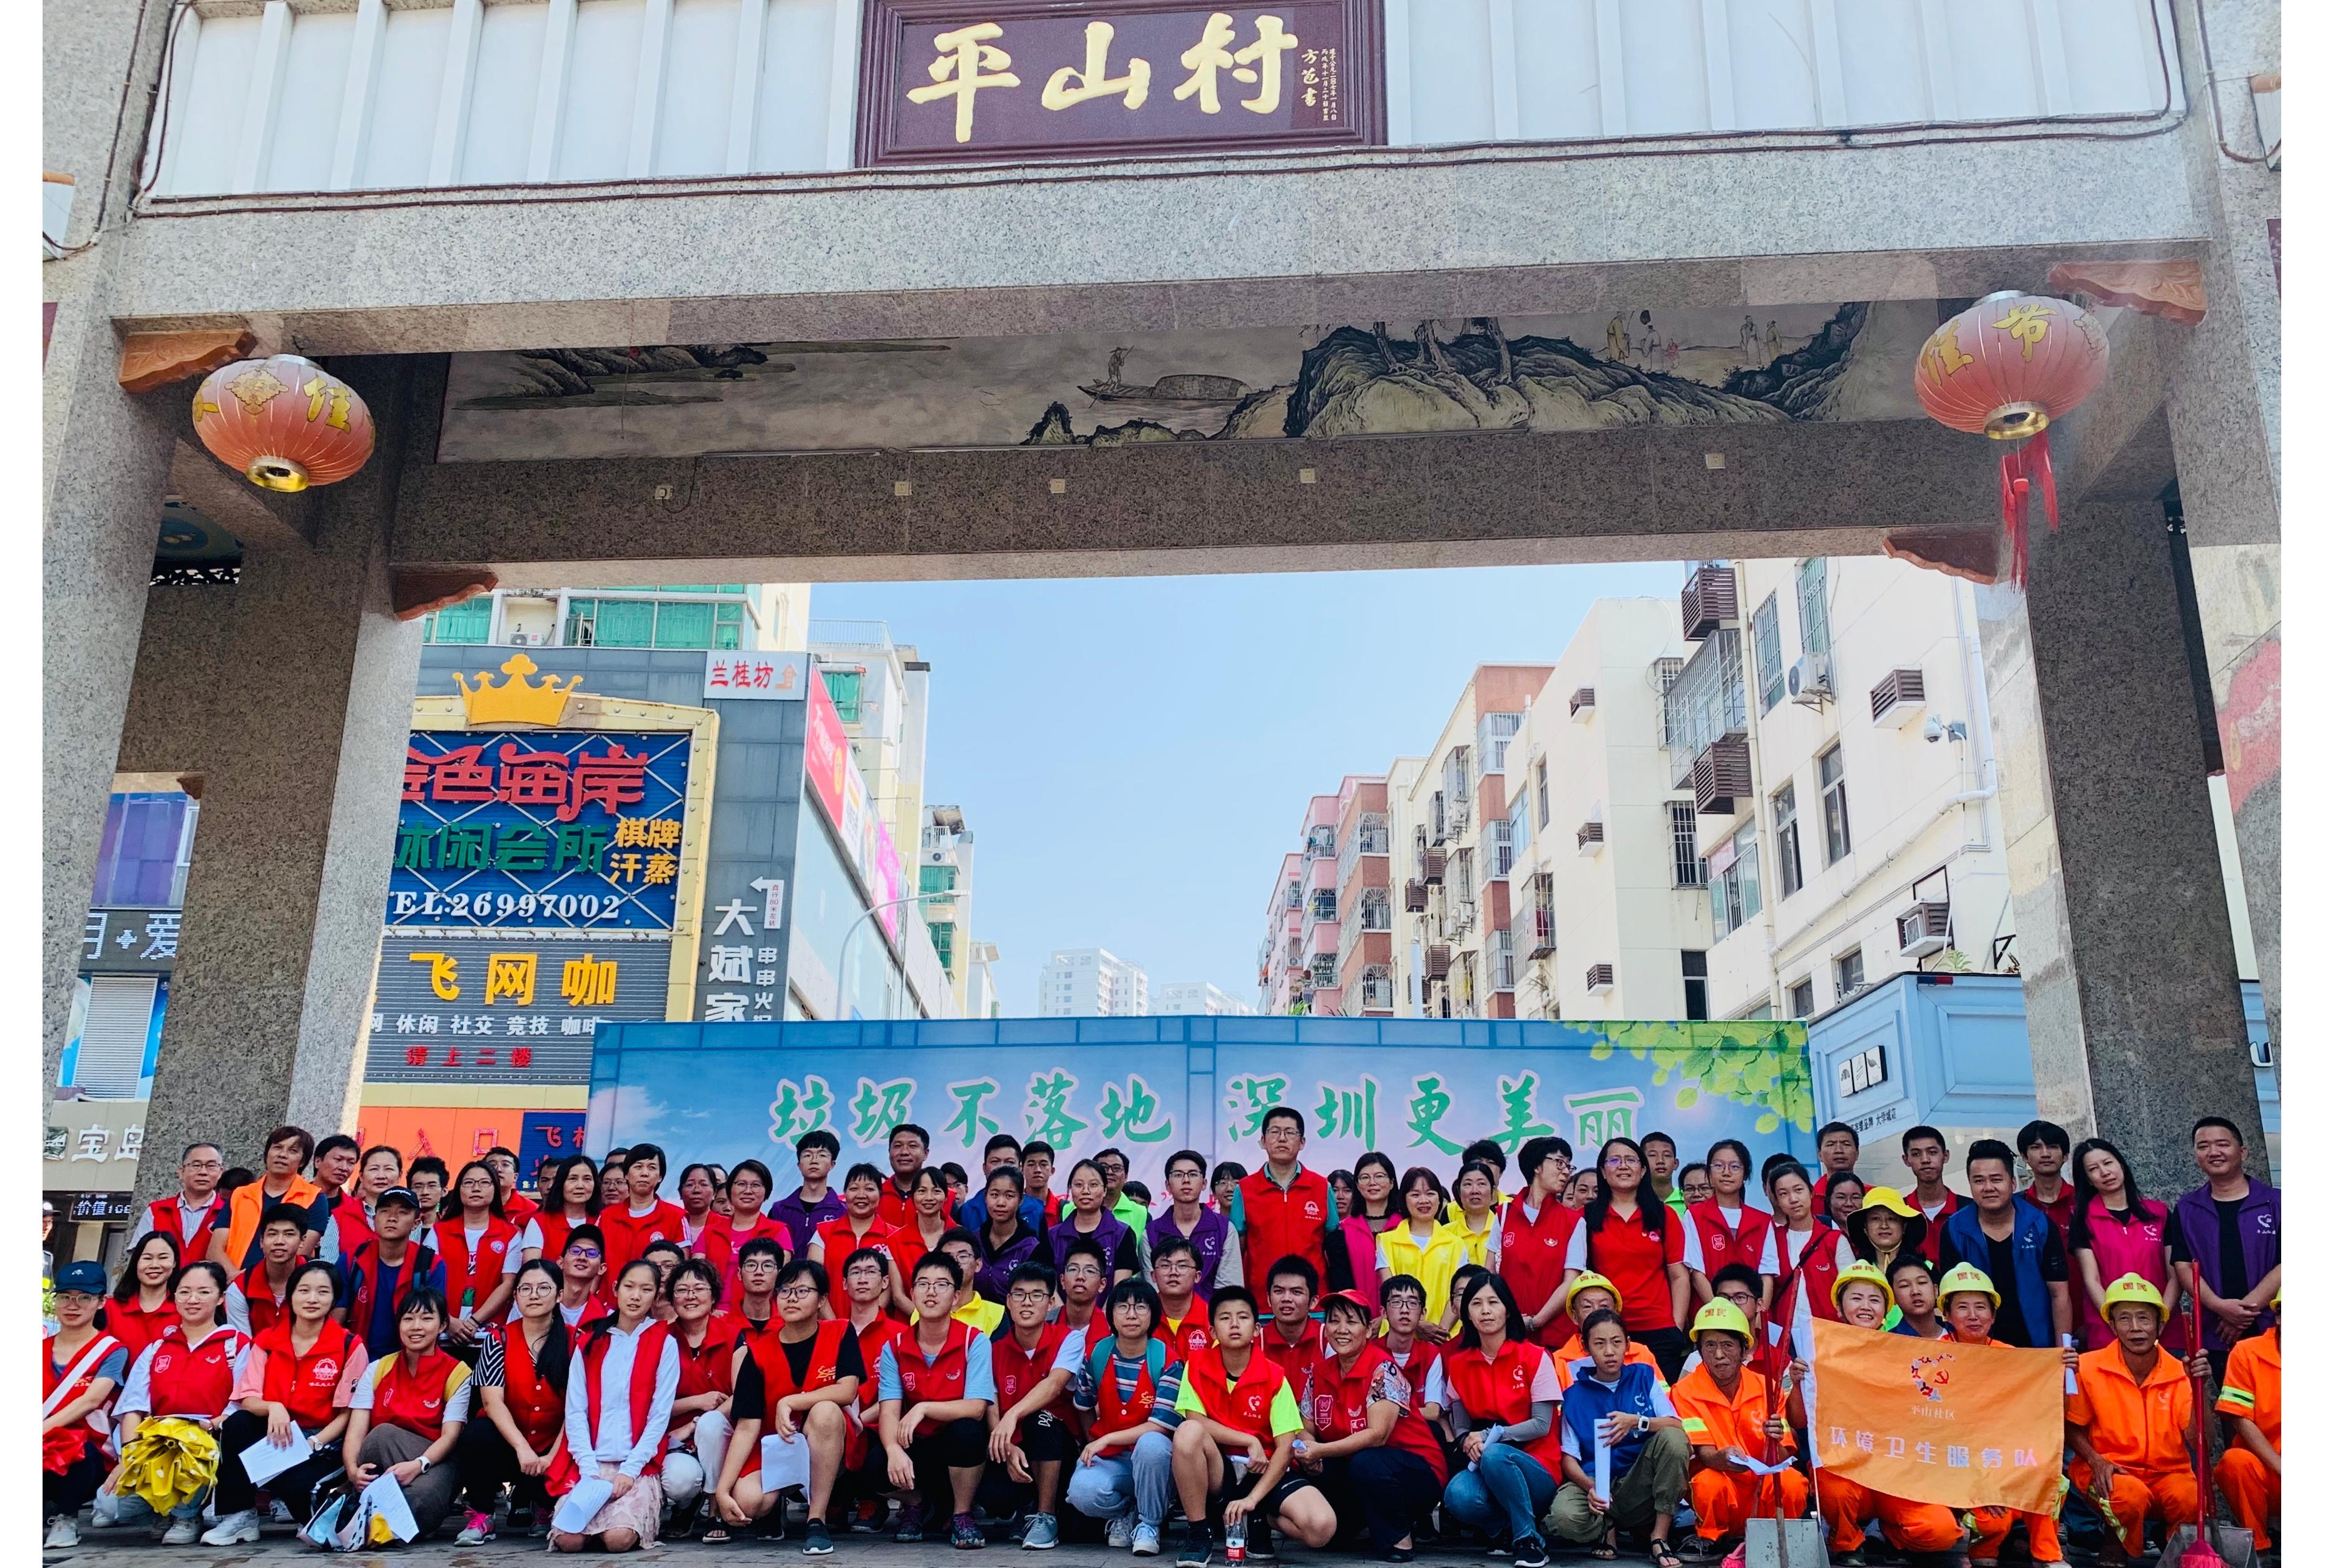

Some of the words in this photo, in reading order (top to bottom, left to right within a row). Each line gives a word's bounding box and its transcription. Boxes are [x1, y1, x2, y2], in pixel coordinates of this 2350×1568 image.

[906, 12, 1299, 143] 平山村
[710, 659, 774, 688] 兰桂坊
[614, 817, 682, 849] 棋牌
[608, 852, 677, 885] 汗蒸
[753, 947, 777, 1021] 串串火
[396, 1013, 439, 1035] 休闲
[450, 1014, 494, 1036] 社交
[506, 1015, 549, 1036] 竞技
[406, 1046, 533, 1068] 请上二楼
[772, 1070, 1174, 1149] 垃圾不落地
[1226, 1072, 1640, 1156] 深圳更美丽
[1829, 1426, 2038, 1469] 环境卫生服务队
